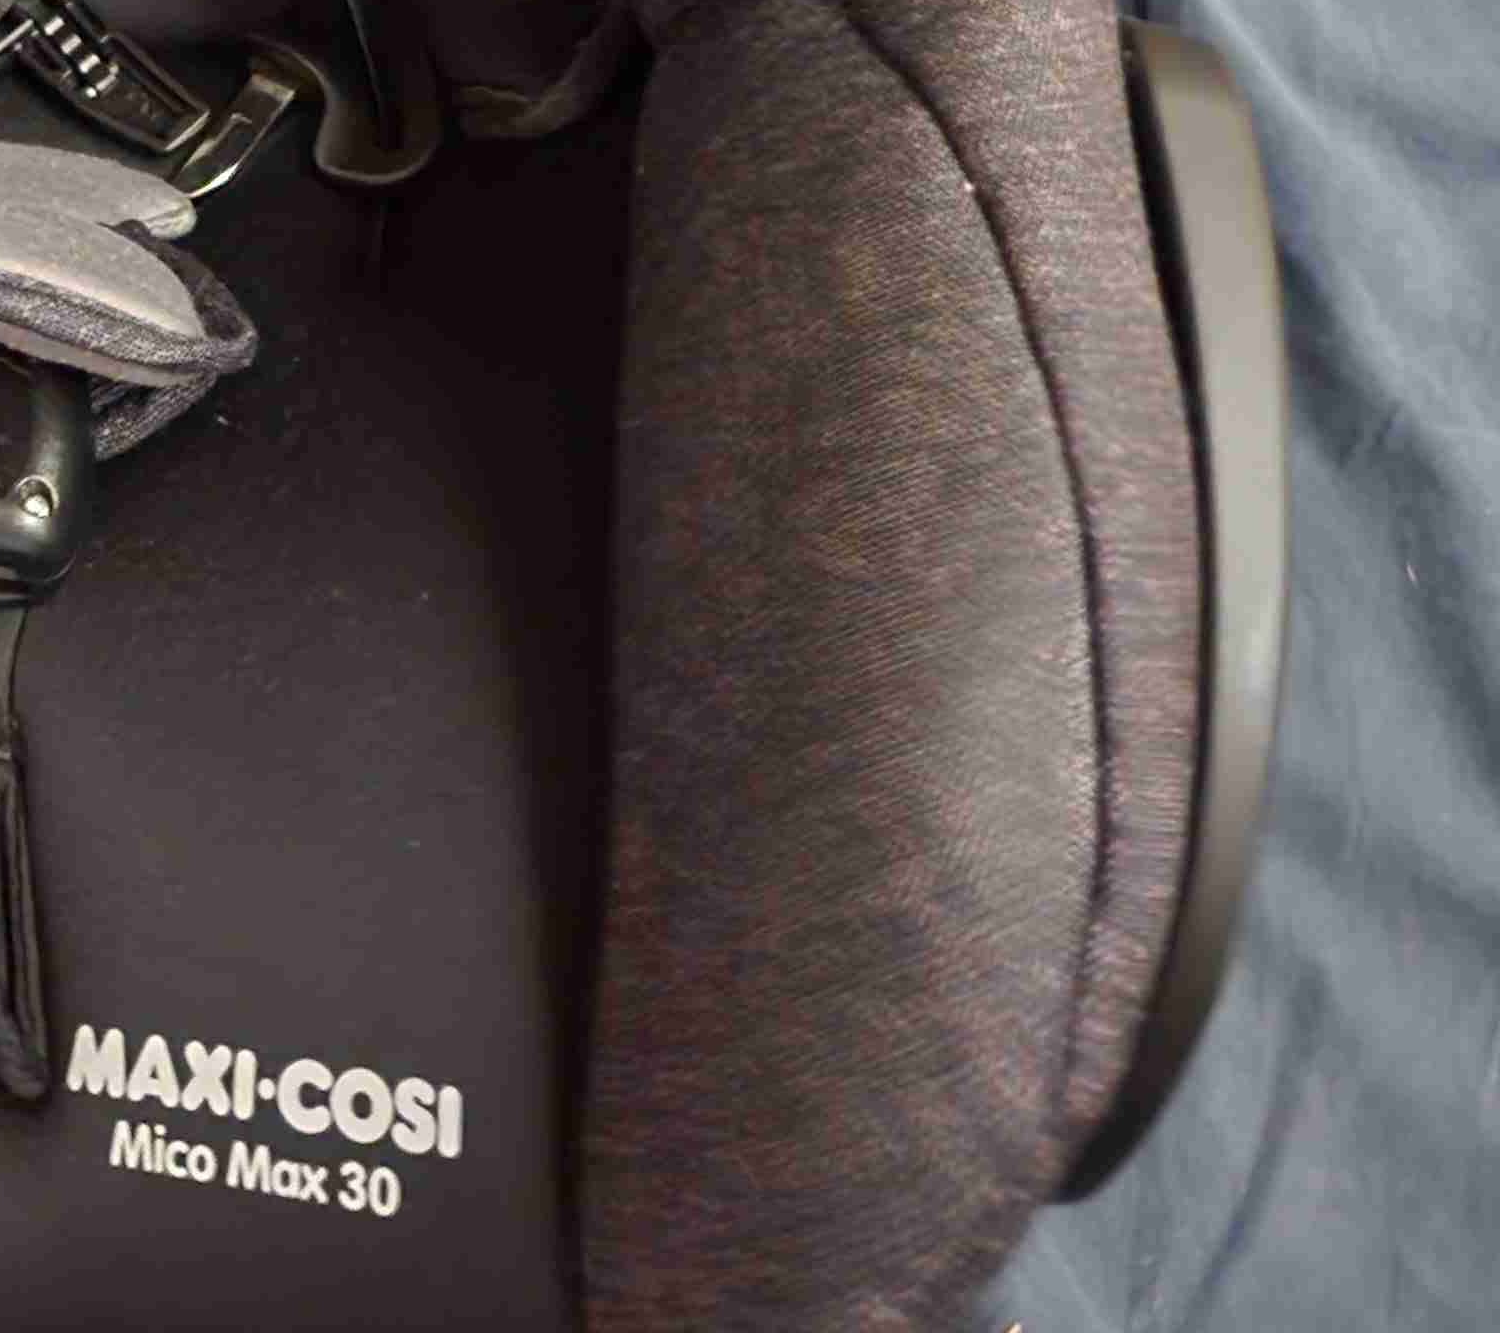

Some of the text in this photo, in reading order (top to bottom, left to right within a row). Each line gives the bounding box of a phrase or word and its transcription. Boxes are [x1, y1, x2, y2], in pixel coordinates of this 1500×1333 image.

[109, 1119, 401, 1217] Mico Max 30
